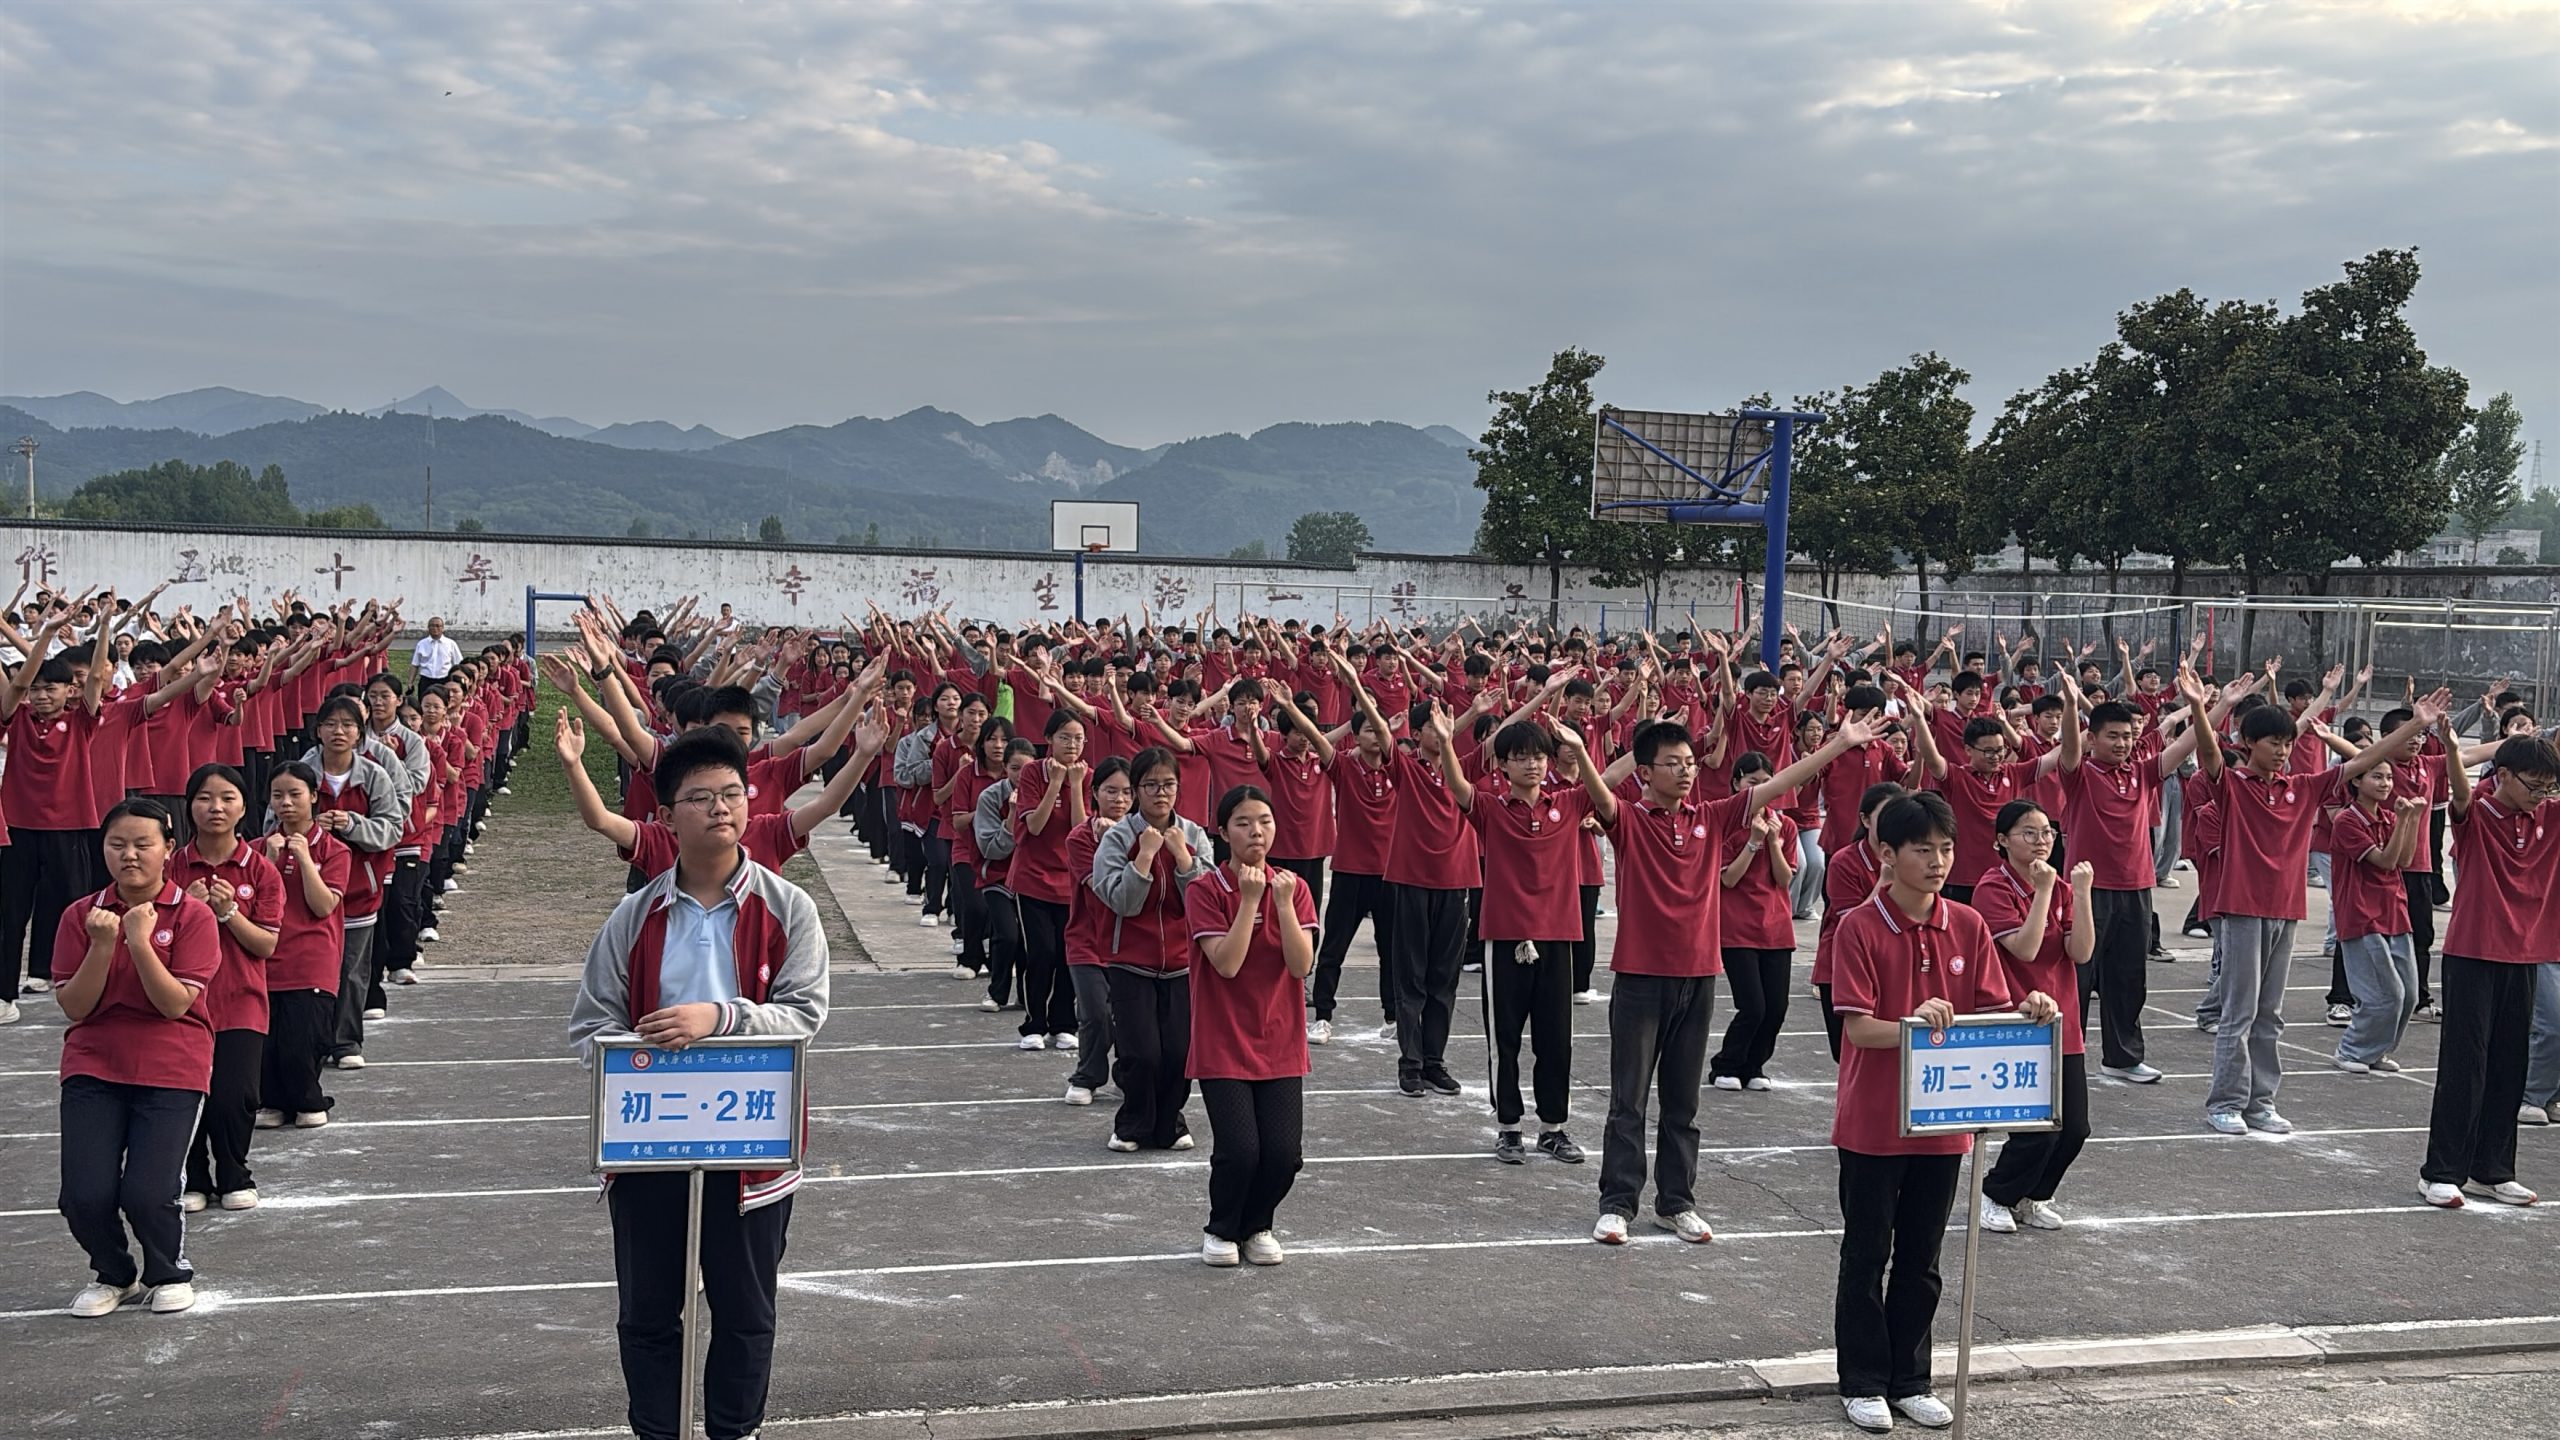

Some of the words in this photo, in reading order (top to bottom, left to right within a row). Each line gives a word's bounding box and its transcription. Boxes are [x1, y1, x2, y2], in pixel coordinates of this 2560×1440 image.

[1922, 1060, 2038, 1093] 初二·3班
[621, 1089, 776, 1123] 初二·2班
[705, 1143, 728, 1155] 博学
